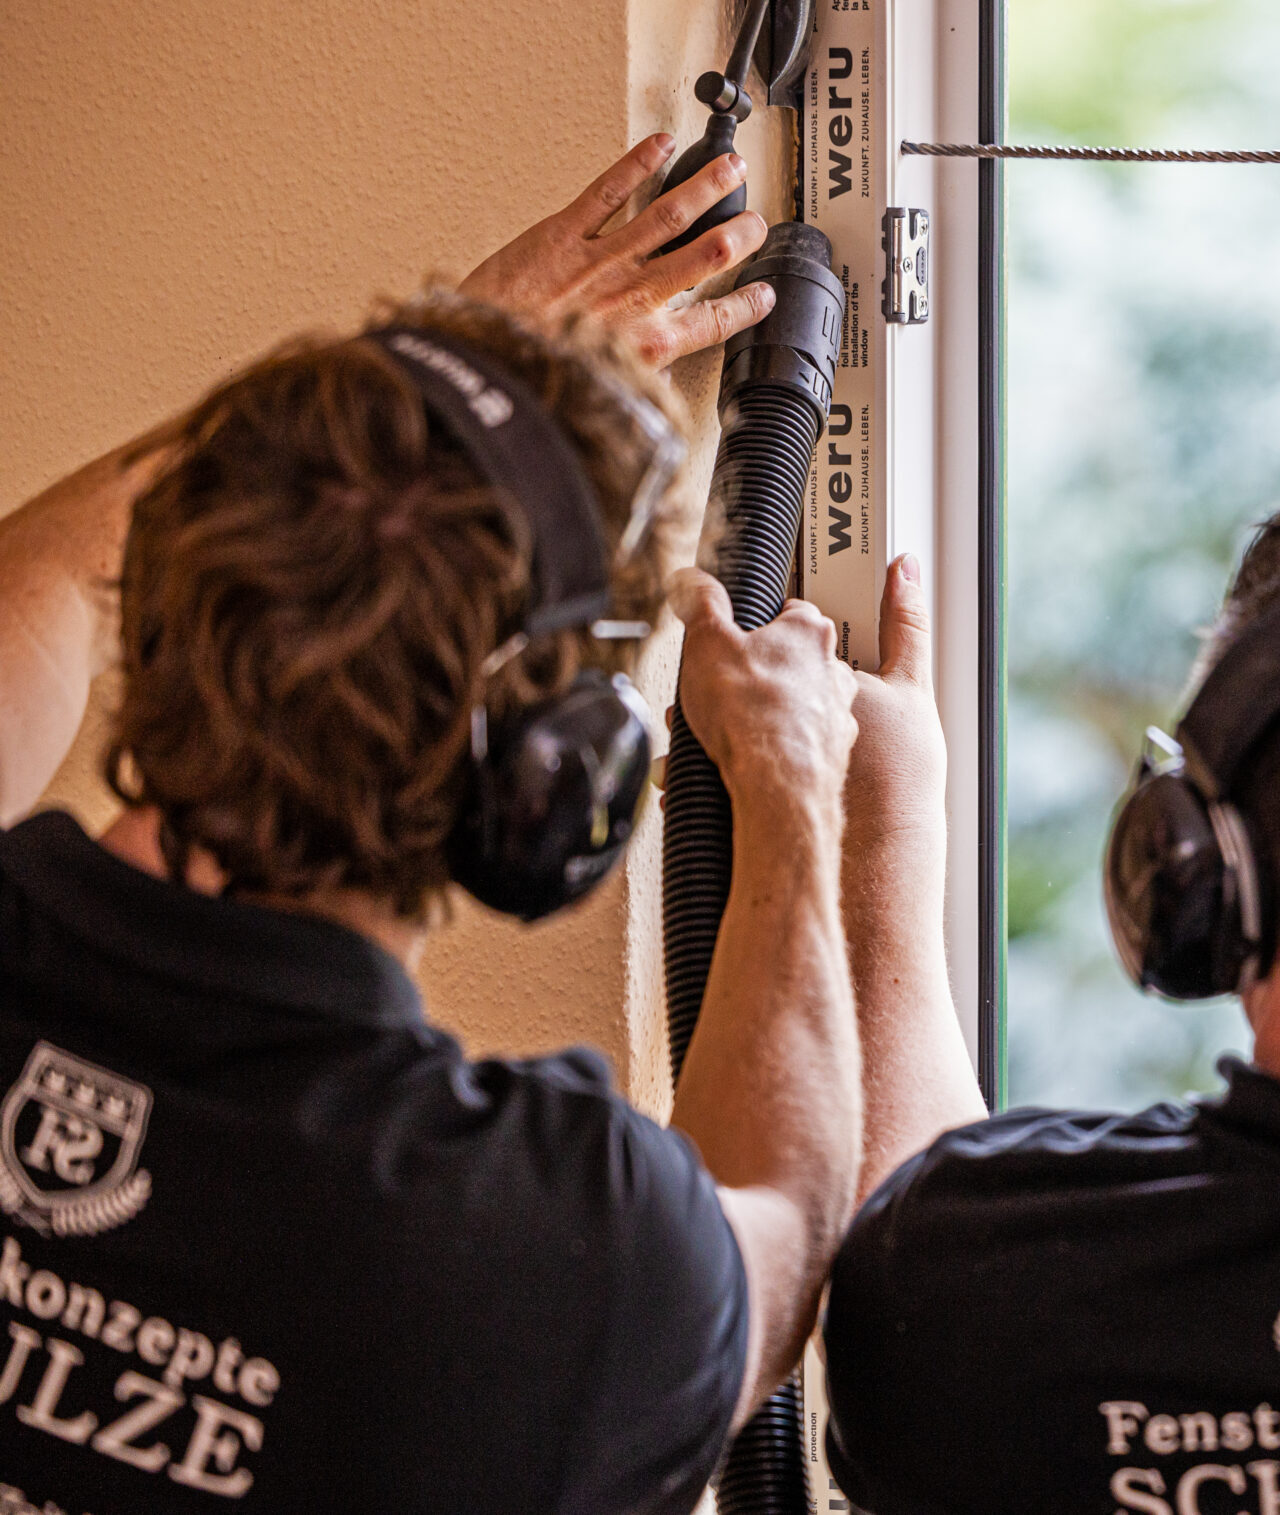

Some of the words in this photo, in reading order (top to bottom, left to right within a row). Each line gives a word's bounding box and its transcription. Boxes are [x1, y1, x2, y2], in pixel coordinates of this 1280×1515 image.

[861, 46, 870, 85] LEBEN.
[828, 47, 853, 200] weru
[861, 88, 870, 142] ZUHAUSE.
[861, 145, 870, 198] ZUKUNFT.
[841, 264, 849, 288] after
[851, 282, 859, 300] the
[851, 301, 859, 312] of
[841, 352, 849, 368] foil
[851, 319, 859, 368] installation
[861, 329, 869, 368] window
[861, 404, 870, 442] LEBEN.
[810, 466, 818, 520] ZUHAUSE.
[828, 404, 853, 557] weru
[861, 445, 870, 499] ZUHAUSE.
[810, 522, 818, 575] ZUKUNFT.
[861, 502, 870, 555] ZUKUNFT.
